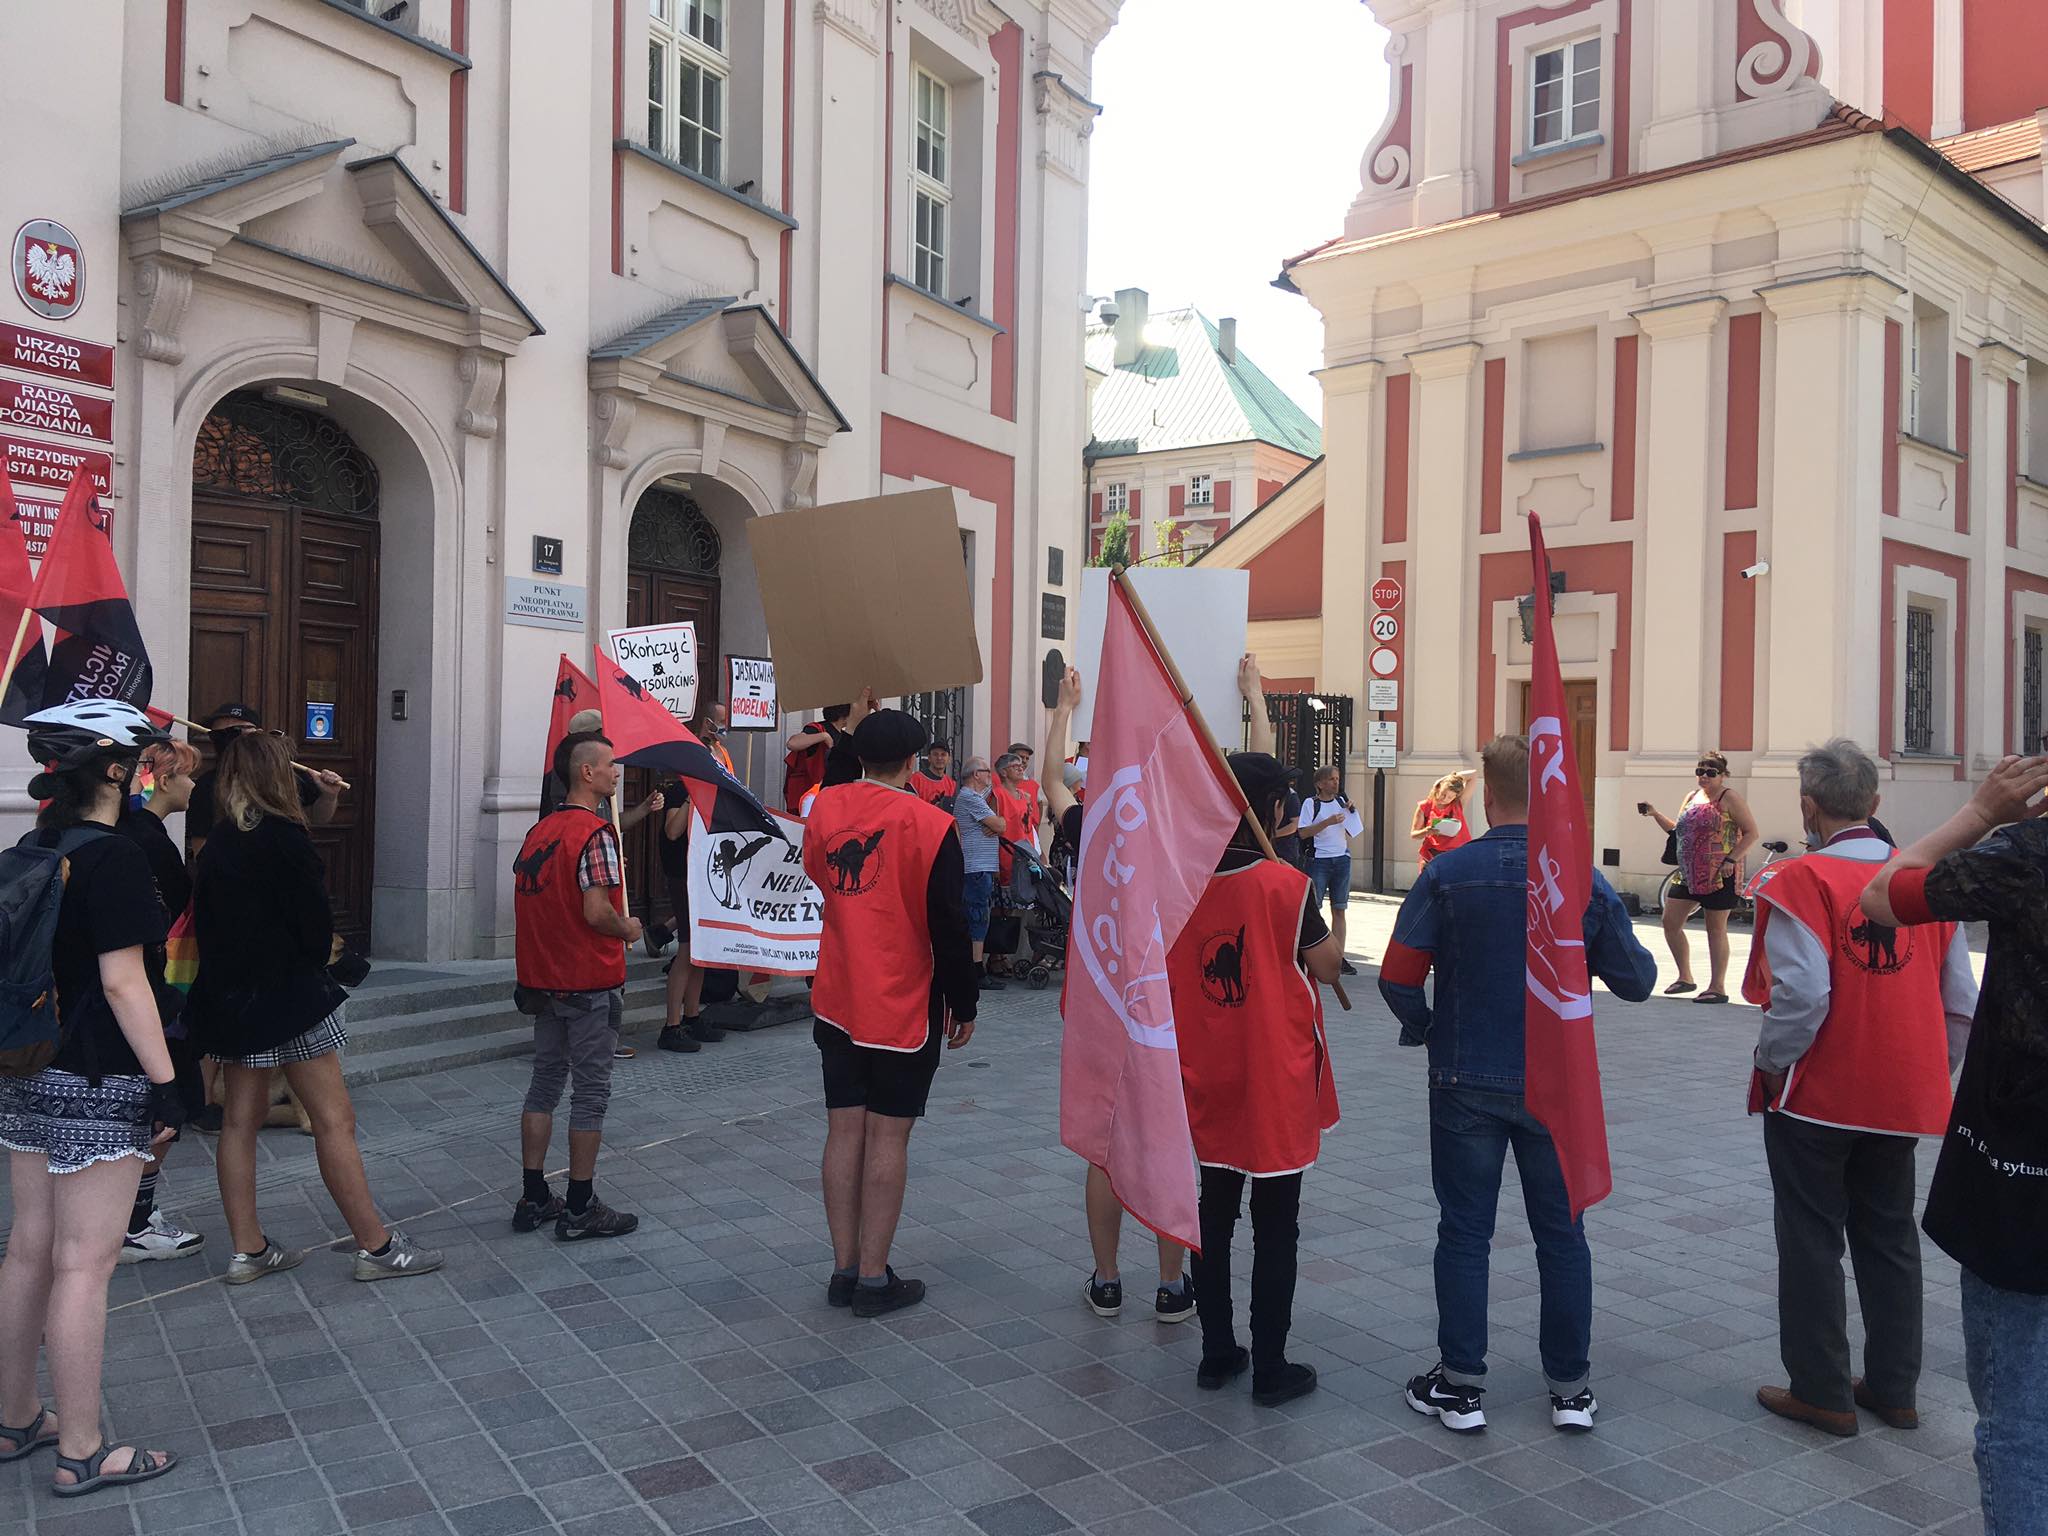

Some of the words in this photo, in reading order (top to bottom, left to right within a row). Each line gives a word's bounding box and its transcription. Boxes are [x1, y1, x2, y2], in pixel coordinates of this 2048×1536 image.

[16, 334, 81, 359] URZĄD
[14, 347, 81, 372] MIASTA
[21, 385, 73, 406] RADA
[14, 396, 81, 420] MIASTA
[0, 407, 94, 436] POZNANIA
[544, 544, 554, 557] 17
[533, 585, 562, 597] PUNKT
[1374, 589, 1399, 599] STOP
[512, 603, 546, 616] POMOCY
[1376, 620, 1396, 636] 20
[734, 660, 775, 683] JAŚKOWIA
[761, 872, 795, 893] NIE
